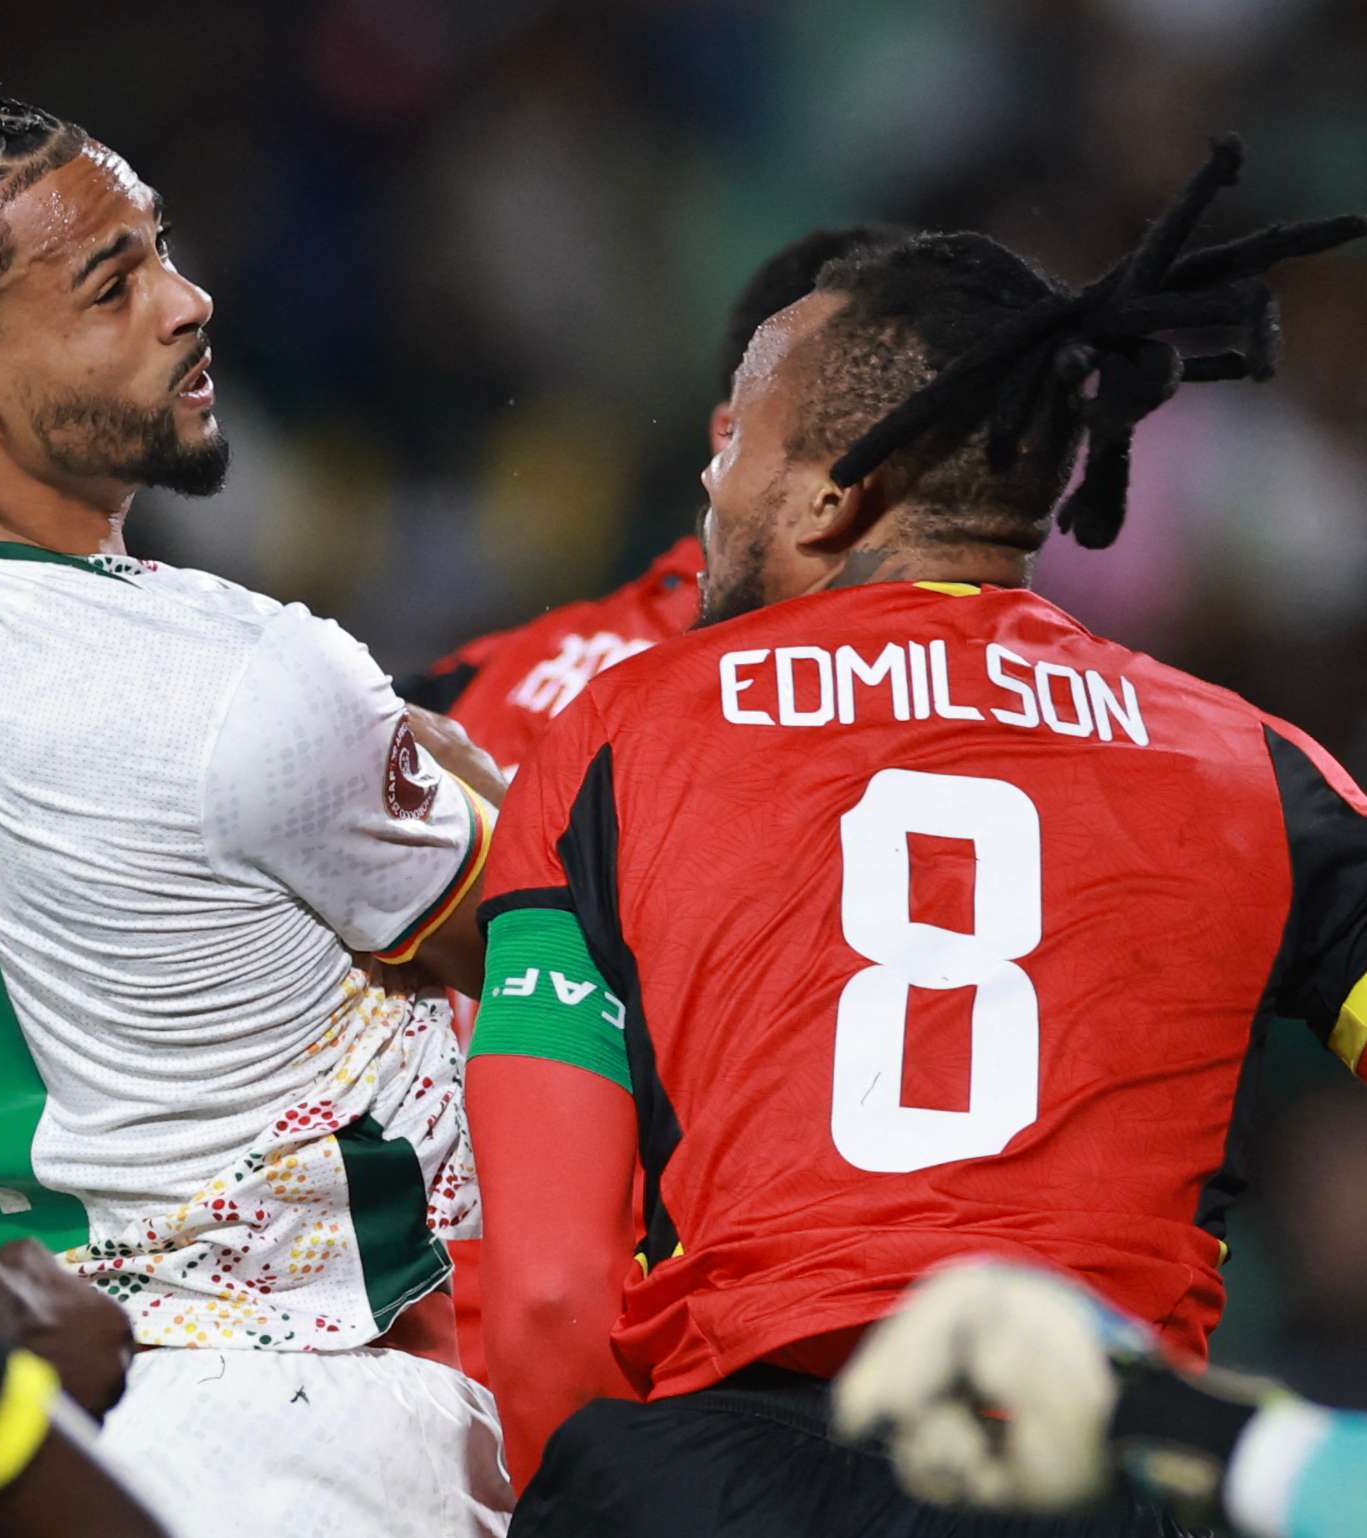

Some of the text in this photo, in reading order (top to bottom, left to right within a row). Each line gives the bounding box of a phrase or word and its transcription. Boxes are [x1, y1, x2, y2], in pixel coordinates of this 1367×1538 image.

[719, 640, 1149, 747] EDMILSON
[502, 967, 626, 1030] CAF
[831, 768, 1043, 1174] 8
